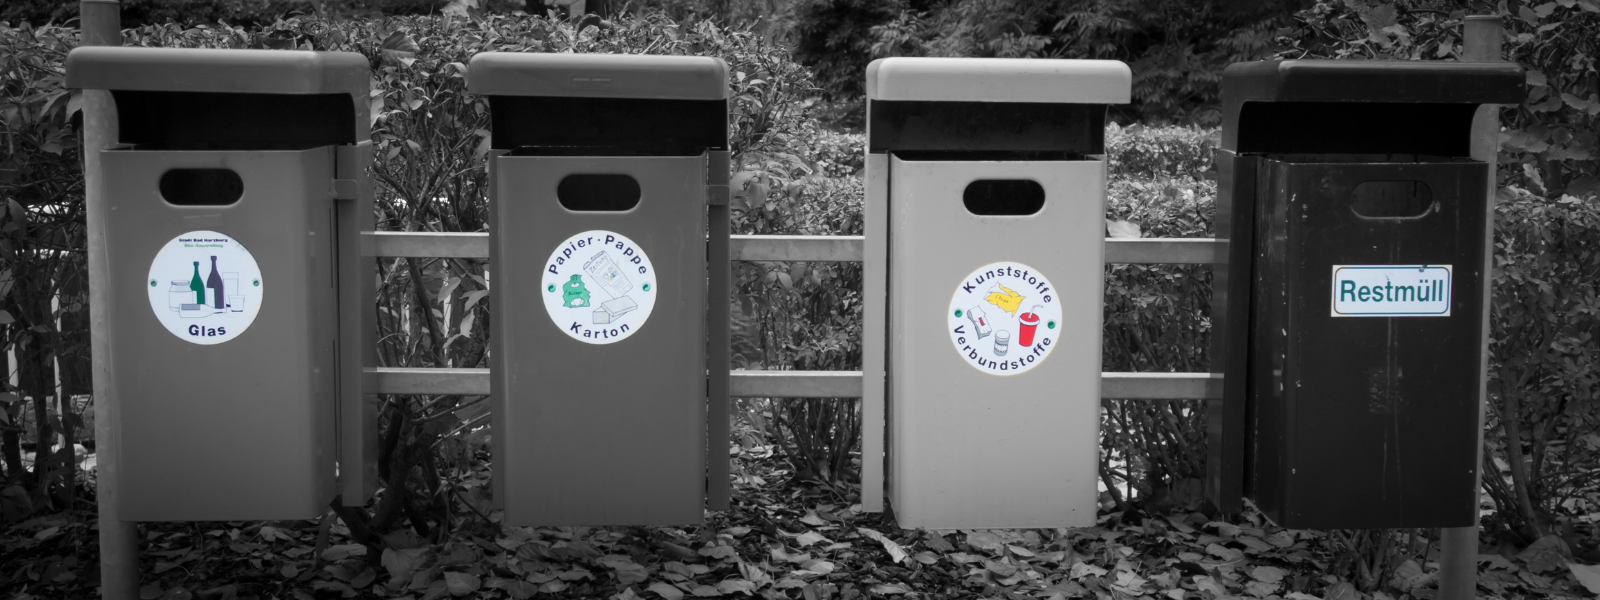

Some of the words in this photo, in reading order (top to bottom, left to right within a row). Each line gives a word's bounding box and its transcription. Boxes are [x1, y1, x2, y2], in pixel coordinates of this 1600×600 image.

[548, 236, 593, 275] Papier
[604, 234, 647, 274] Pappe
[963, 266, 1052, 303] Kunststoffe
[1340, 279, 1444, 302] Restmüll
[188, 324, 226, 337] Glas
[570, 321, 630, 339] Karton
[953, 324, 1052, 371] Verbundstoffe
